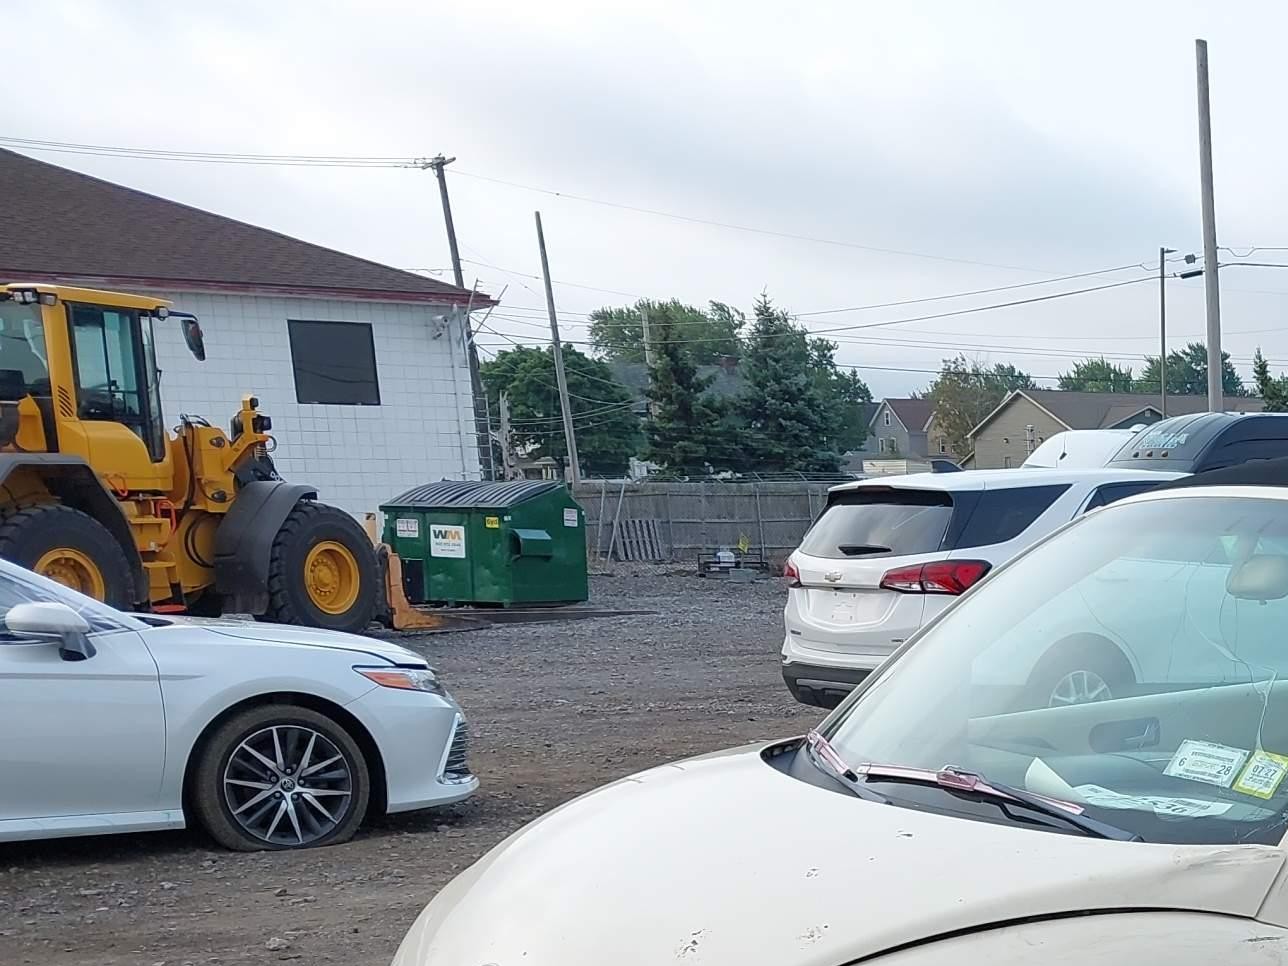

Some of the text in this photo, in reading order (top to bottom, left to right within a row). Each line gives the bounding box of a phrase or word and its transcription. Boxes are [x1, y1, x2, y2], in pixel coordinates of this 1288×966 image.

[433, 529, 462, 540] WM
[1178, 757, 1187, 767] 6
[1216, 765, 1233, 776] 28
